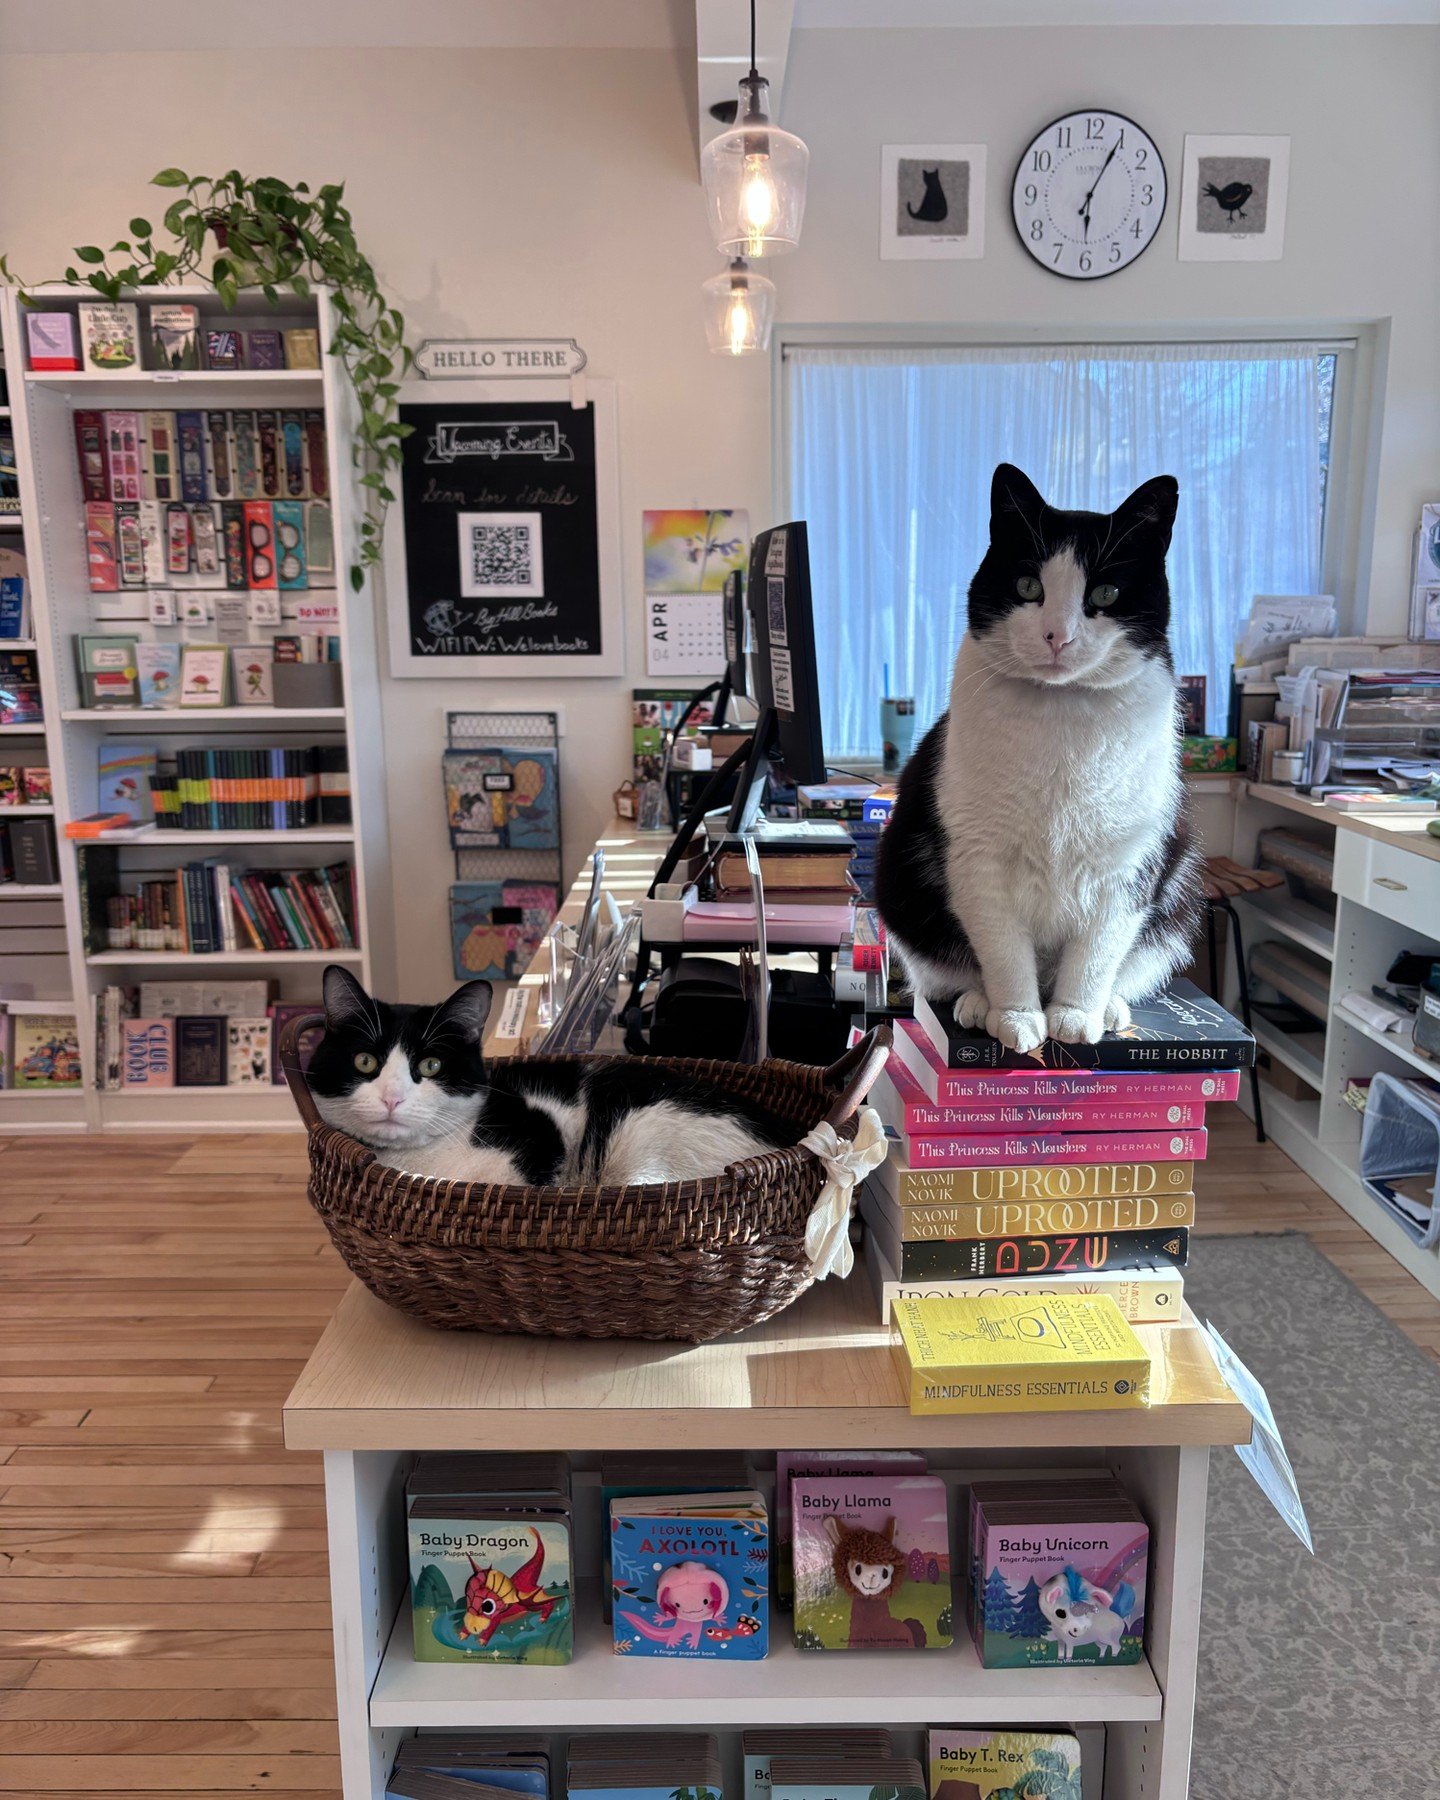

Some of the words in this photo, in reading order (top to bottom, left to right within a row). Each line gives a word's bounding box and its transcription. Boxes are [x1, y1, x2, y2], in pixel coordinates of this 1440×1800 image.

[1057, 127, 1072, 148] 11
[1086, 118, 1104, 140] 12
[1033, 150, 1051, 171] 10
[1135, 149, 1148, 171] 2
[1025, 184, 1037, 207] 9
[1142, 184, 1153, 207] 3
[1030, 219, 1043, 240] 8
[1130, 218, 1143, 238] 4
[1053, 244, 1064, 264] 7
[1079, 250, 1092, 272] 6
[1109, 243, 1121, 264] 5
[434, 352, 495, 367] HELLO
[501, 351, 567, 367] THERE
[505, 426, 553, 451] Events
[653, 603, 668, 641] APR
[415, 637, 461, 653] WIFI
[127, 1029, 148, 1082] BOOK
[149, 1024, 169, 1072] CLUB
[1128, 1049, 1160, 1059] THE
[1166, 1049, 1228, 1059] HOBBIT
[946, 1082, 973, 1096] This
[977, 1081, 1029, 1095] Princess
[1034, 1080, 1058, 1095] Kills
[1060, 1080, 1117, 1095] Monsters
[1126, 1085, 1140, 1093] RY
[913, 1109, 940, 1122] This
[944, 1109, 995, 1122] Princess
[1000, 1108, 1023, 1122] Kills
[1027, 1107, 1083, 1121] Monsters
[918, 1143, 945, 1157] This
[949, 1142, 1000, 1156] Princess
[1004, 1141, 1028, 1155] Kills
[1030, 1139, 1087, 1154] Monsters
[907, 1174, 954, 1187] NAOMI
[972, 1164, 1157, 1200] UPROOTED
[908, 1189, 952, 1202] NOVIK
[911, 1210, 958, 1223] NAOMI
[976, 1198, 1158, 1235] UPROOTED
[912, 1224, 956, 1237] NOVIK
[1119, 1282, 1128, 1311] IERCE
[1130, 1282, 1139, 1318] BROWN
[1049, 1300, 1092, 1355] MINDFULNESS
[1071, 1303, 1111, 1351] ESSENTIALS
[924, 1383, 1021, 1399] MINDFULNESS
[1027, 1381, 1108, 1396] ESSENTIALS
[802, 1495, 840, 1511] Baby
[845, 1495, 891, 1507] Llama
[420, 1533, 462, 1549] Baby
[466, 1534, 529, 1550] Dragon
[651, 1526, 656, 1536] I
[659, 1526, 692, 1537] LOVE
[696, 1526, 727, 1538] YOU,
[639, 1540, 739, 1556] AXOLOTL
[999, 1539, 1041, 1553] Baby
[1044, 1538, 1109, 1551] Unicorn
[940, 1747, 976, 1764] Baby
[982, 1748, 993, 1762] T.
[998, 1749, 1024, 1763] Rex
[940, 1765, 959, 1774] Finger
[960, 1765, 981, 1774] Puppet
